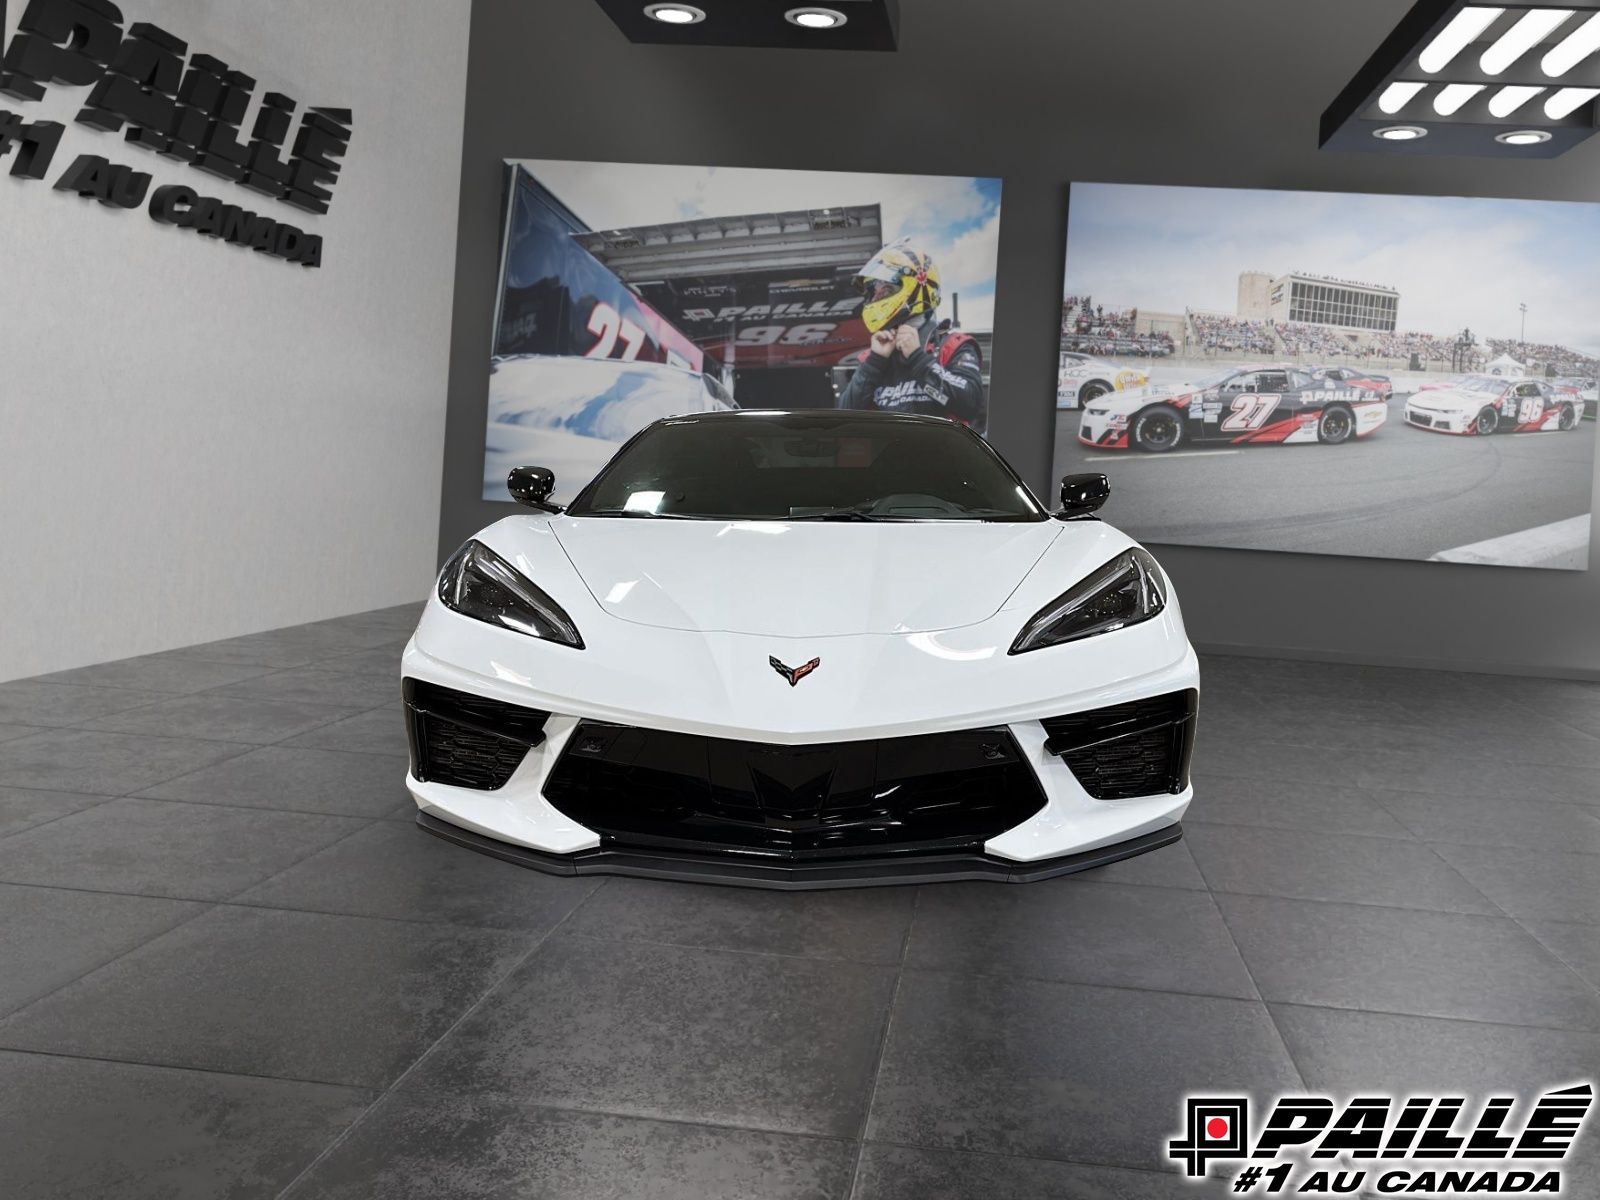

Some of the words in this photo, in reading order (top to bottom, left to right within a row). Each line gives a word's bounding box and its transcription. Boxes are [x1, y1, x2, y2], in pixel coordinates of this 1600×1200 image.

[52, 154, 153, 209] AU
[148, 184, 323, 268] CANADA
[583, 302, 647, 362] 27
[734, 323, 838, 347] 96
[1220, 392, 1282, 432] 27
